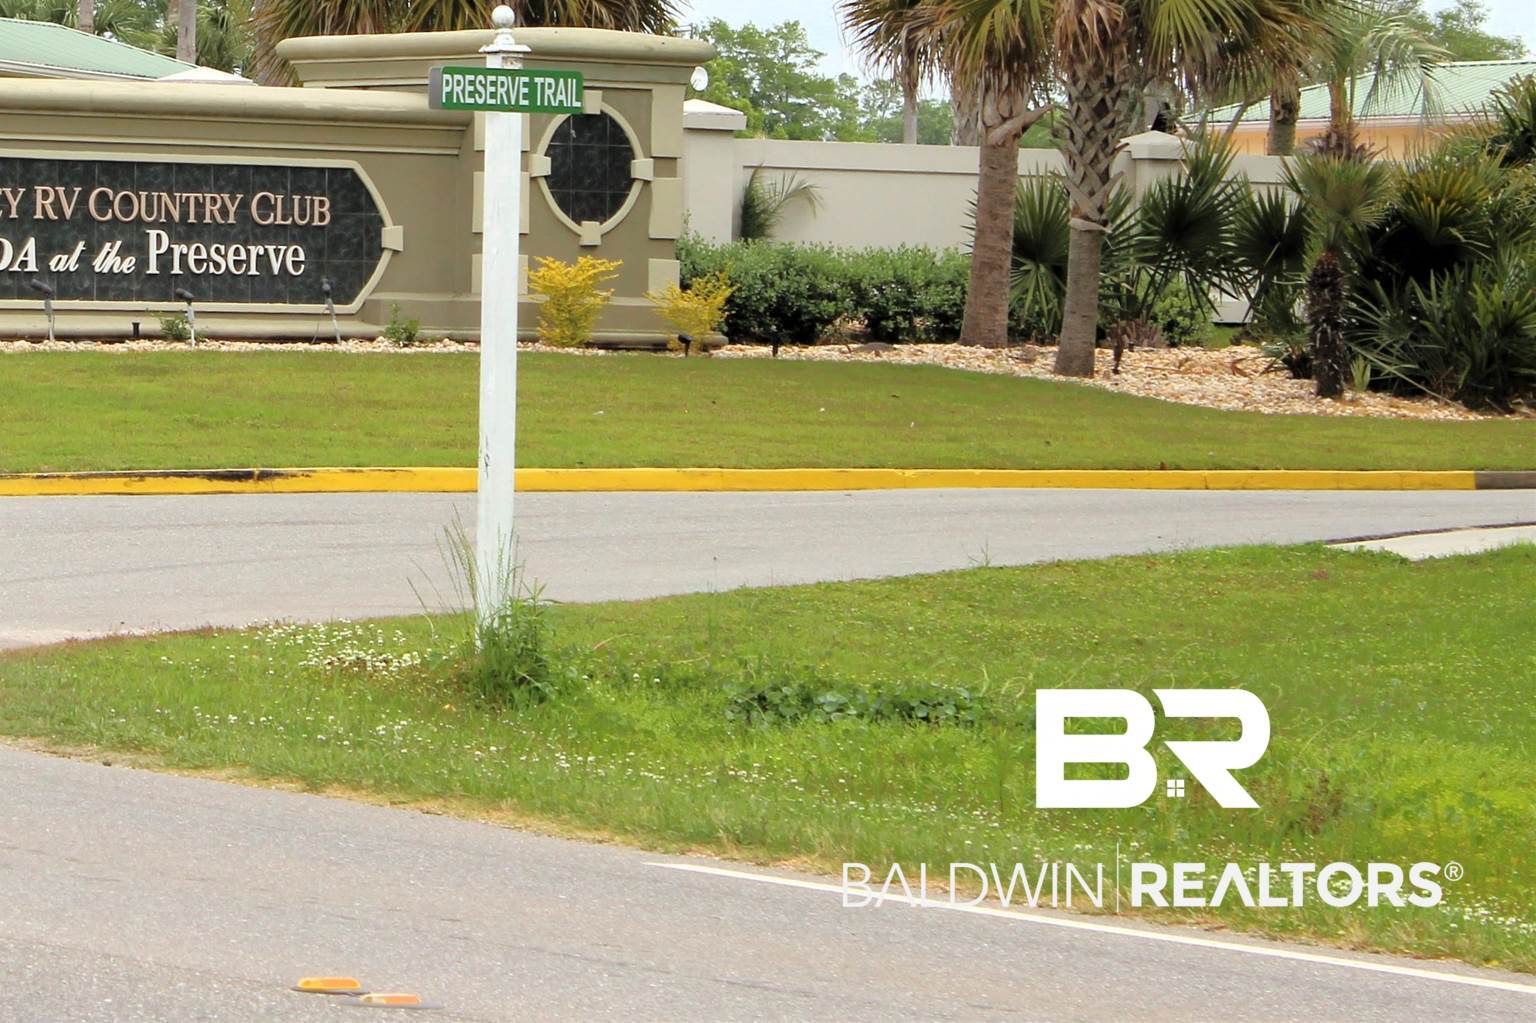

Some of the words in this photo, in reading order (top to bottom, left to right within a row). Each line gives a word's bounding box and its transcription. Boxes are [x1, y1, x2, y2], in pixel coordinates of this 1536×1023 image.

[442, 73, 529, 105] PRESERVE
[534, 78, 582, 107] TRAIL
[33, 185, 80, 220] RV
[88, 187, 244, 224] COUNTRY
[250, 191, 331, 226] CLUB
[48, 240, 86, 273] at
[93, 240, 137, 275] the
[145, 229, 306, 276] Preserve
